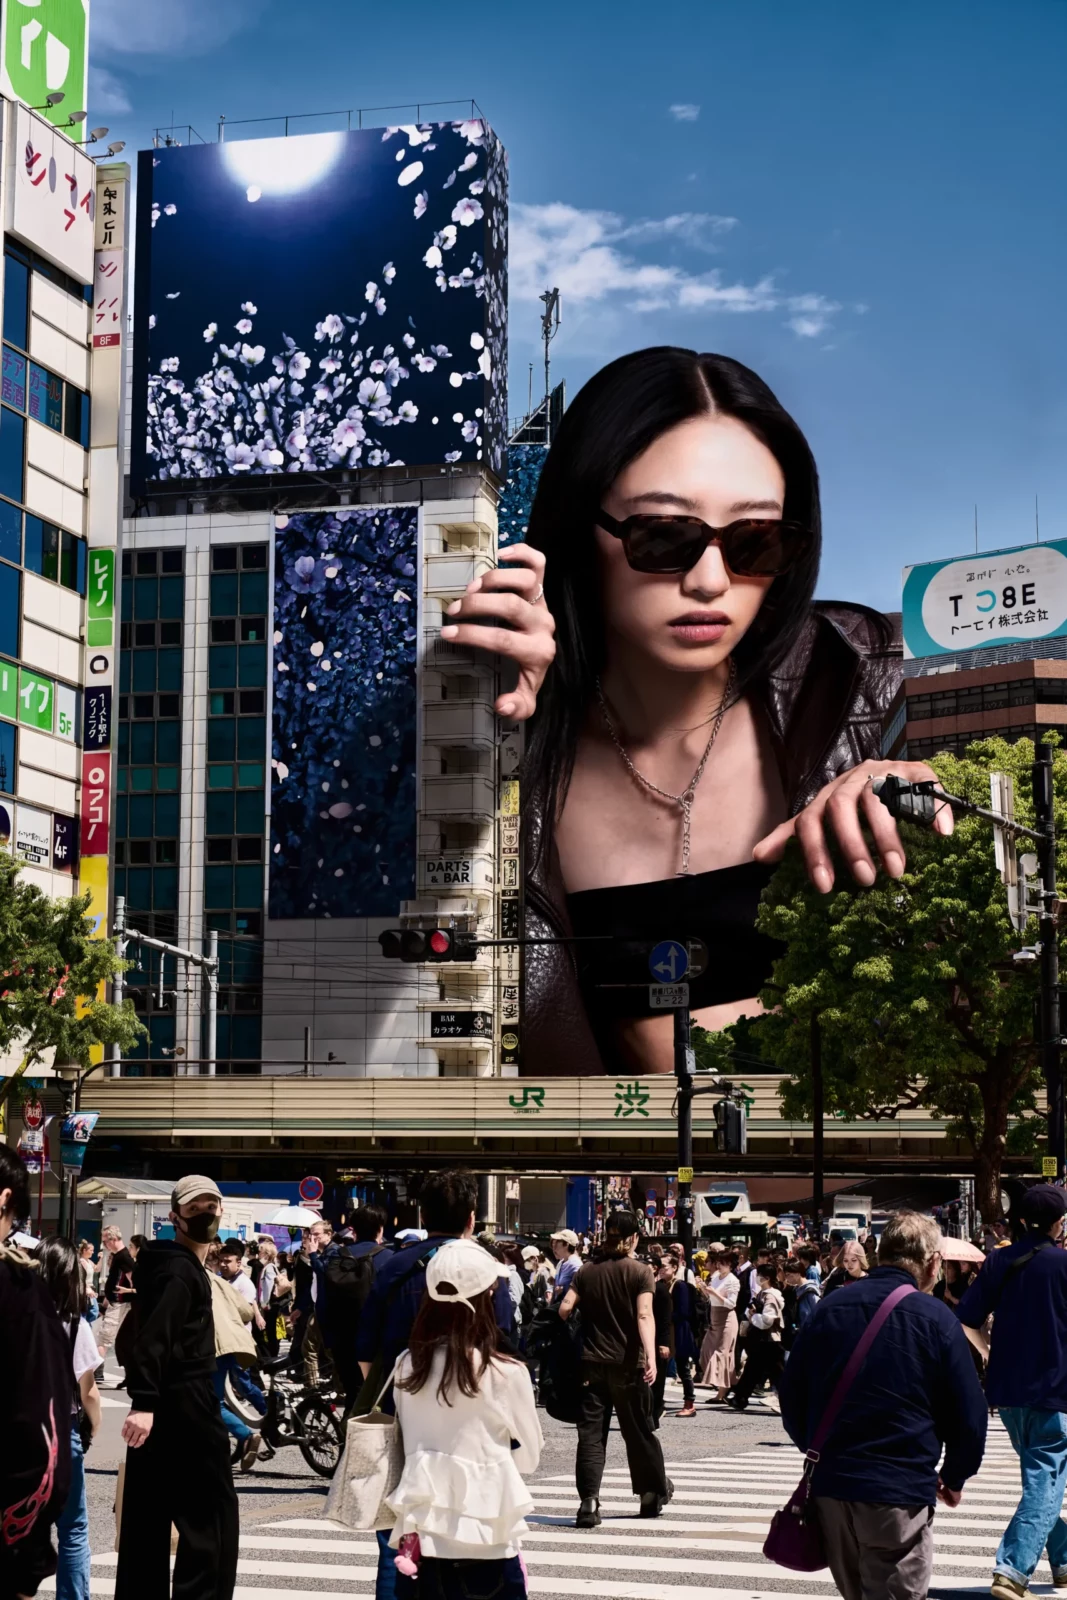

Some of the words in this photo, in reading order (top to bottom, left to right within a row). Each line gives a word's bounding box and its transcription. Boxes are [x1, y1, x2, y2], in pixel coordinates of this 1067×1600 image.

[99, 335, 112, 346] 8F
[49, 409, 60, 427] 7F
[59, 713, 72, 736] 5F
[54, 836, 68, 859] 4F
[427, 861, 470, 872] DARTS
[430, 875, 439, 883] &
[444, 872, 470, 883] BAR
[503, 944, 518, 953] 3F
[433, 1026, 463, 1034] カラオケ
[509, 1087, 545, 1107] JR
